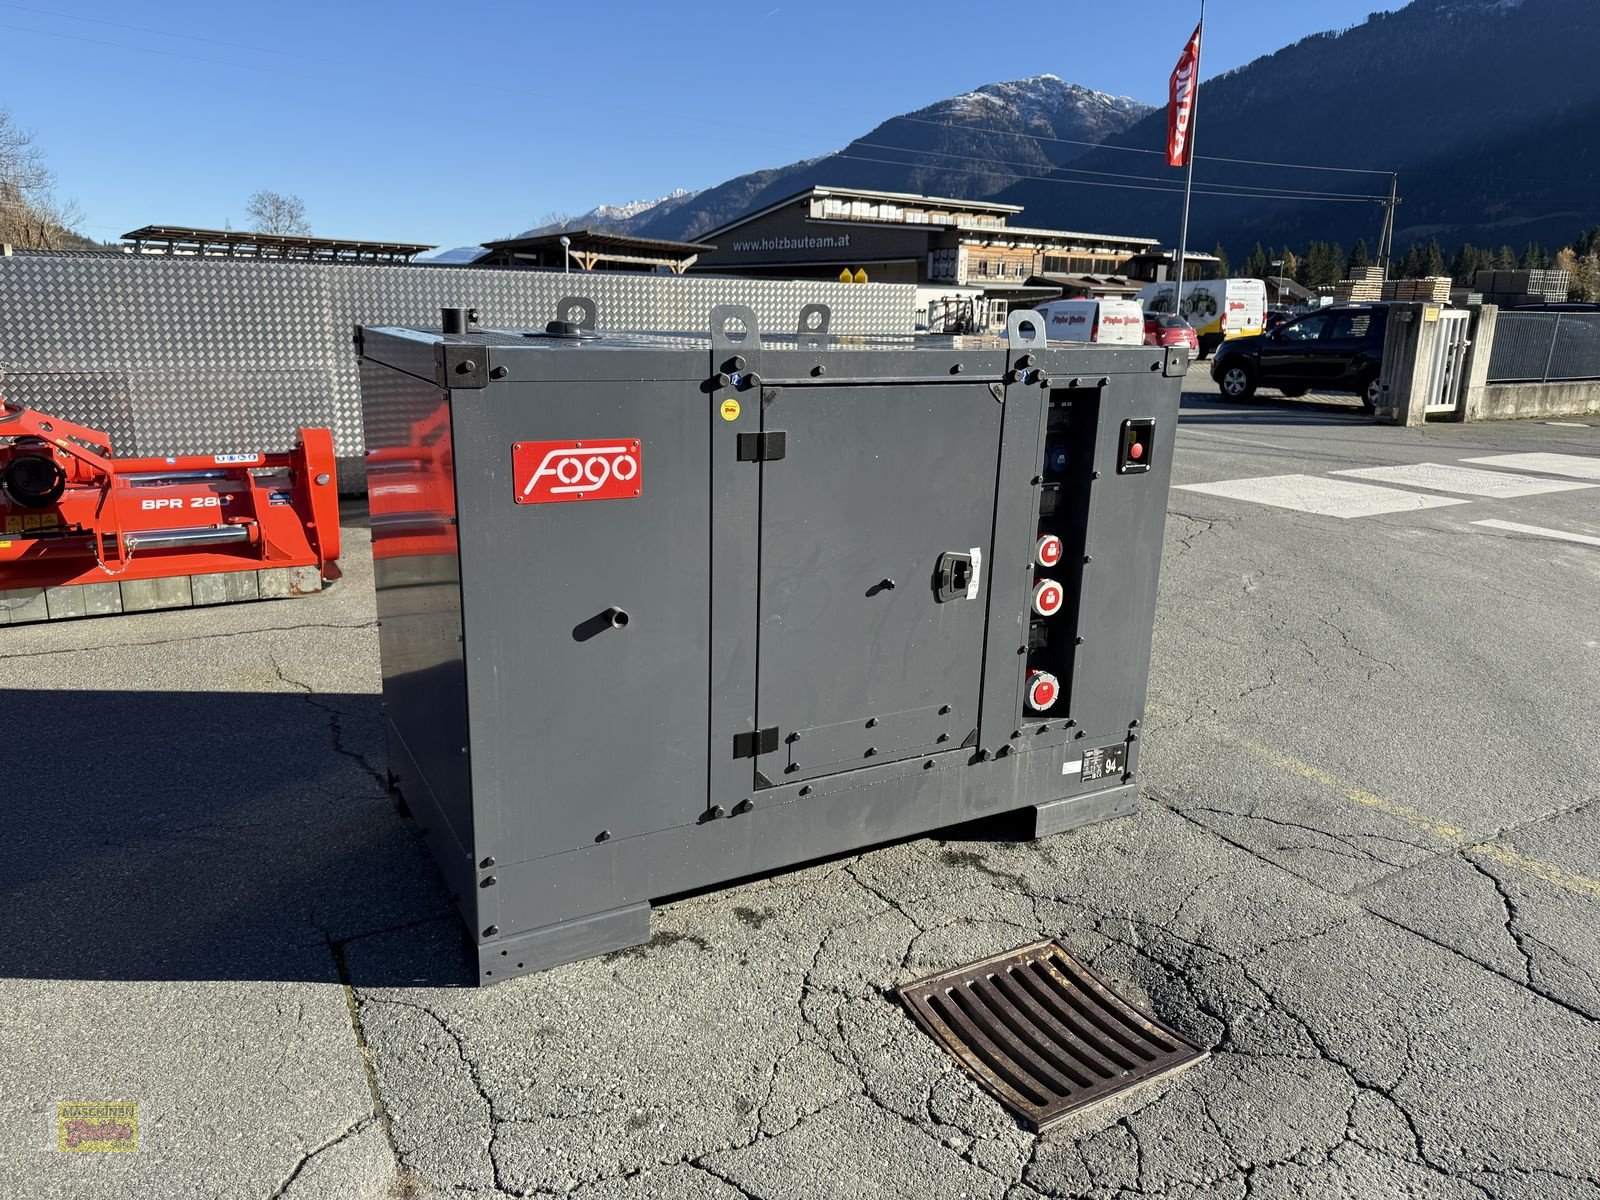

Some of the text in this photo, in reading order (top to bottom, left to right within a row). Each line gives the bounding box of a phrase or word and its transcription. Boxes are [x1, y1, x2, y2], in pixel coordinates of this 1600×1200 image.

[733, 233, 850, 252] www.holzbauteam.at
[142, 498, 183, 510] BPR
[1105, 757, 1117, 774] 94
